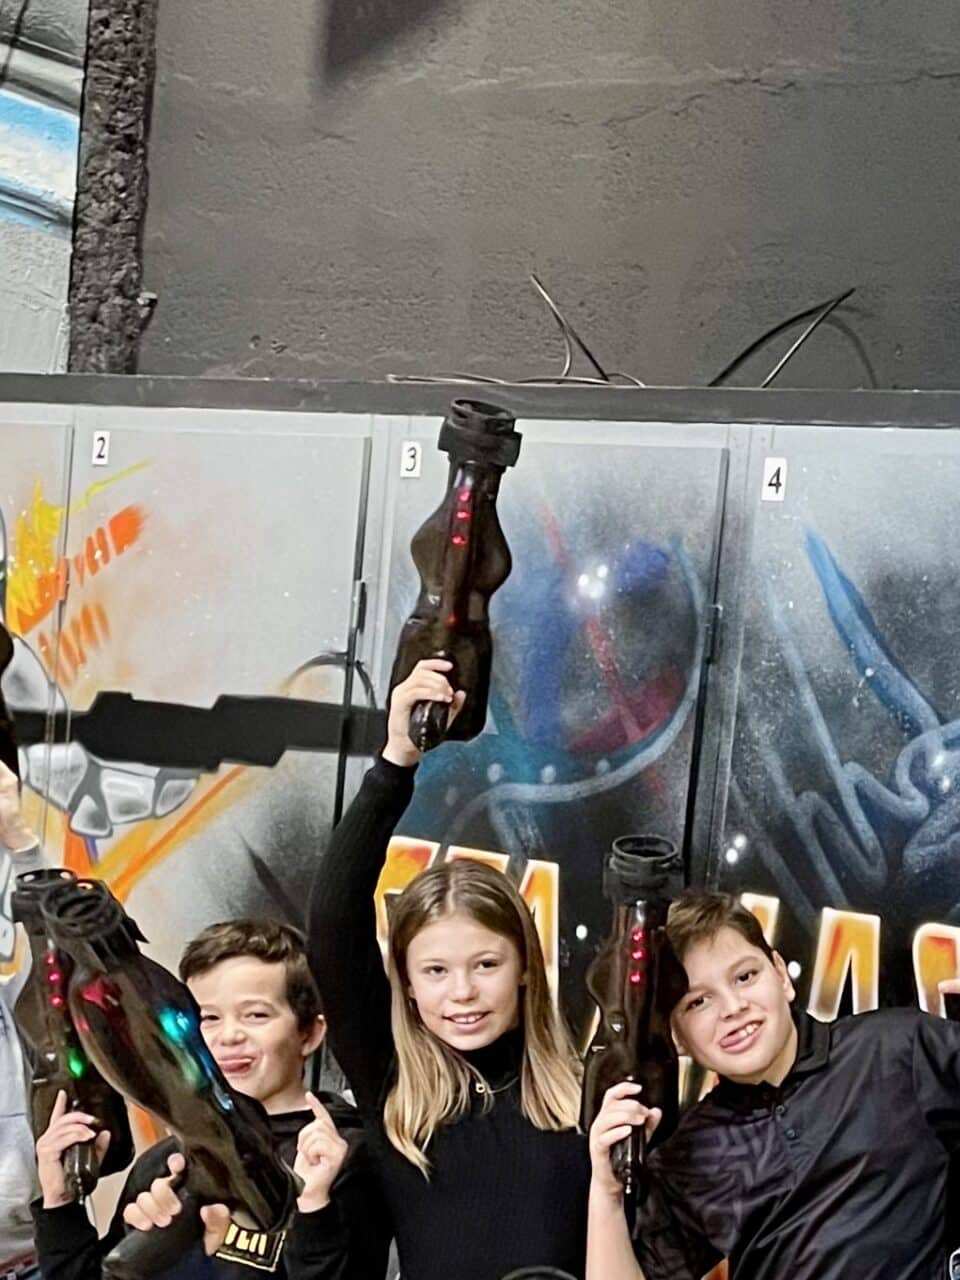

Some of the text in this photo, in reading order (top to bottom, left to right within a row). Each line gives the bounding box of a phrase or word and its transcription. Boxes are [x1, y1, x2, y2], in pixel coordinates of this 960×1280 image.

[96, 436, 106, 459] 2
[405, 446, 417, 472] 3
[767, 466, 782, 494] 4
